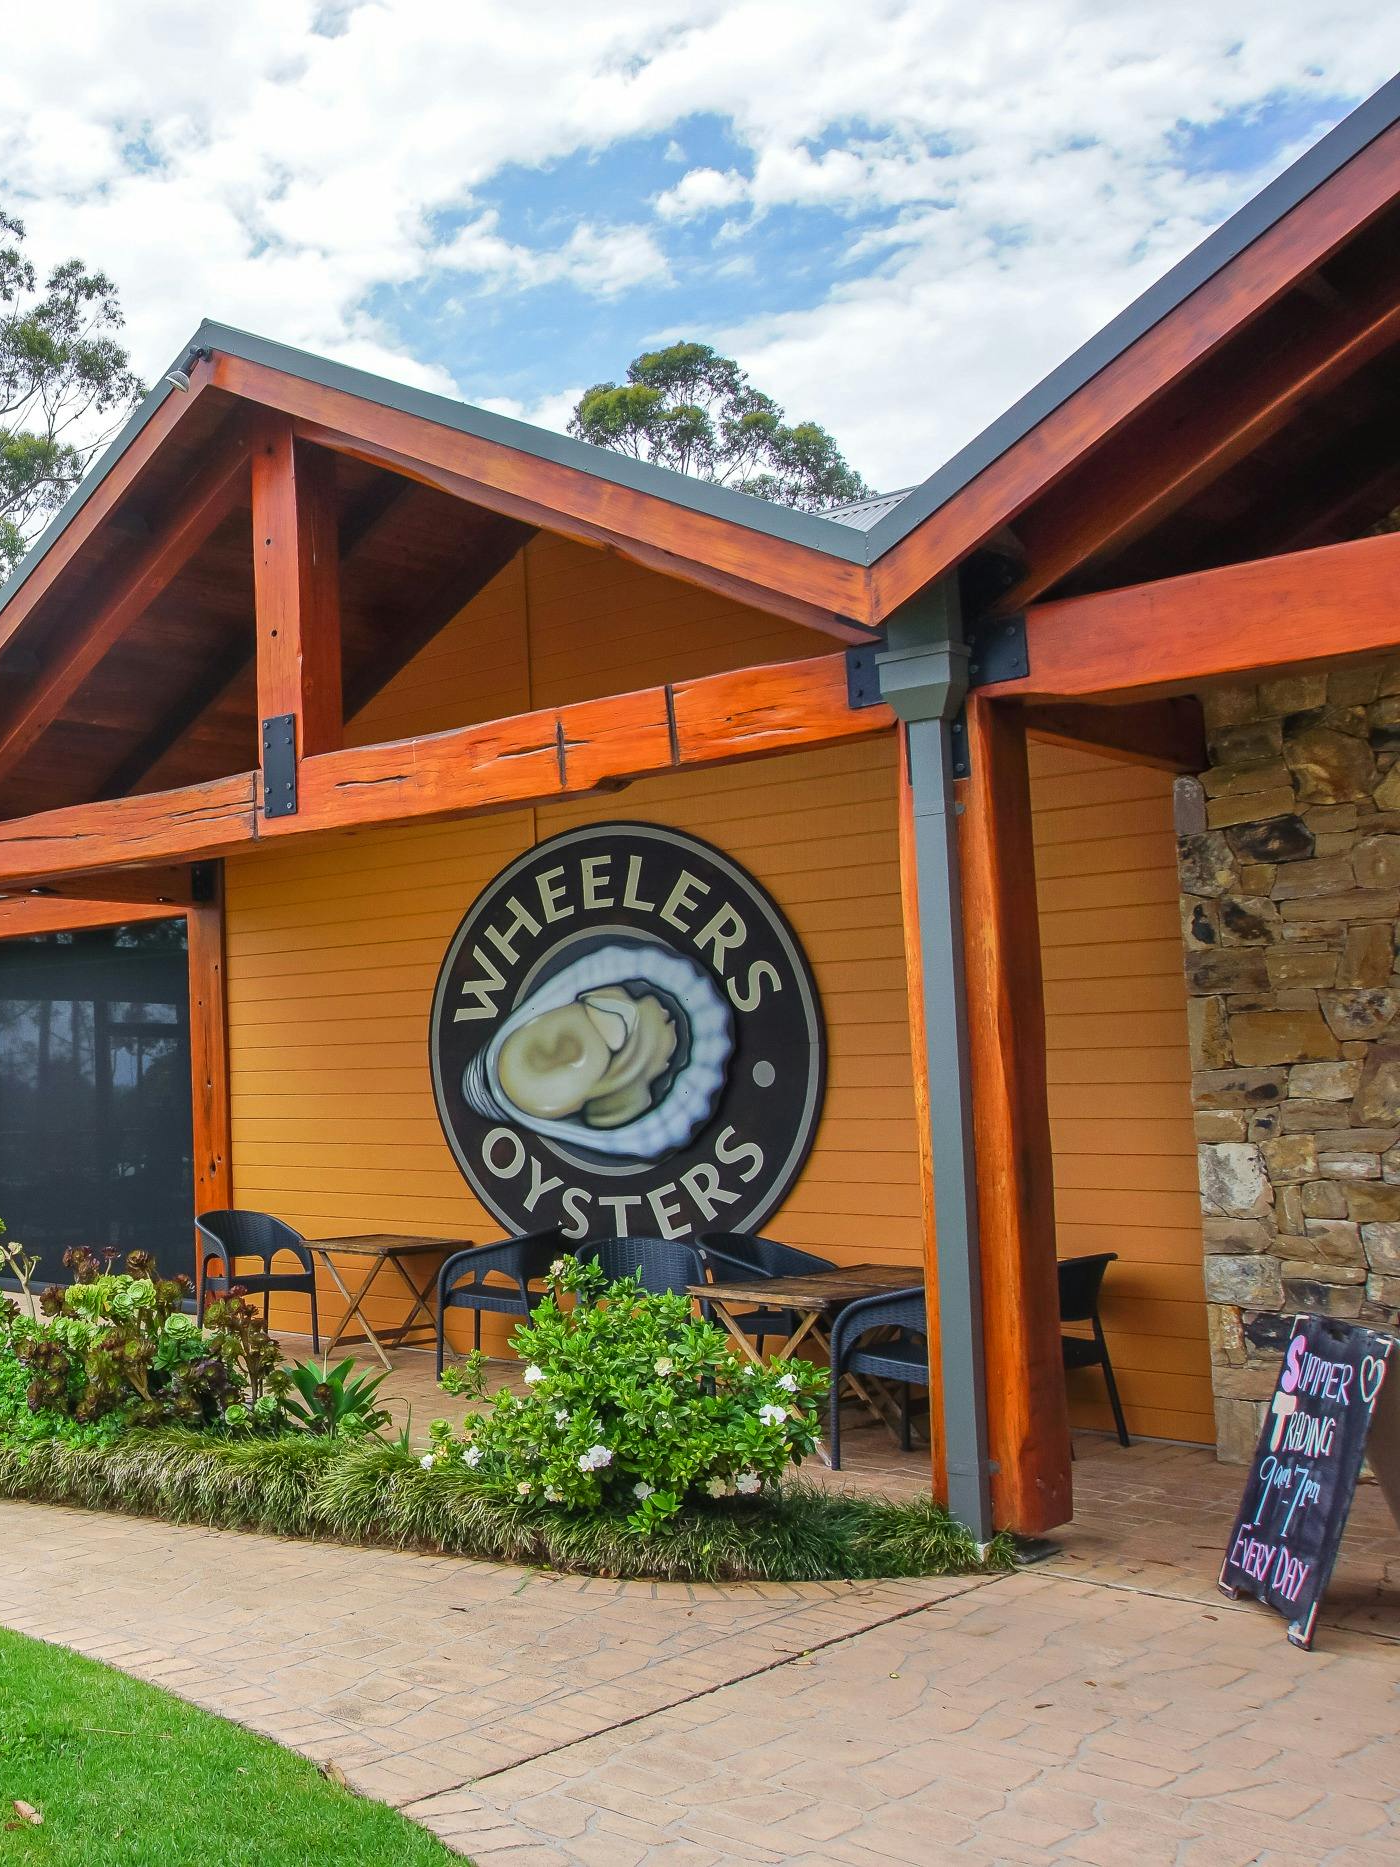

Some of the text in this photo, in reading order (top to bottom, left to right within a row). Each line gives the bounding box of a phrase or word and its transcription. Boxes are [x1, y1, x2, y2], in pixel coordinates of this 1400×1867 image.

[453, 854, 783, 1024] WHEELERS
[481, 1125, 765, 1241] OYSTERS
[1280, 1334, 1354, 1407] SUMMER
[1269, 1390, 1337, 1459] TRADING
[1229, 1523, 1310, 1602] EVERY DAY
